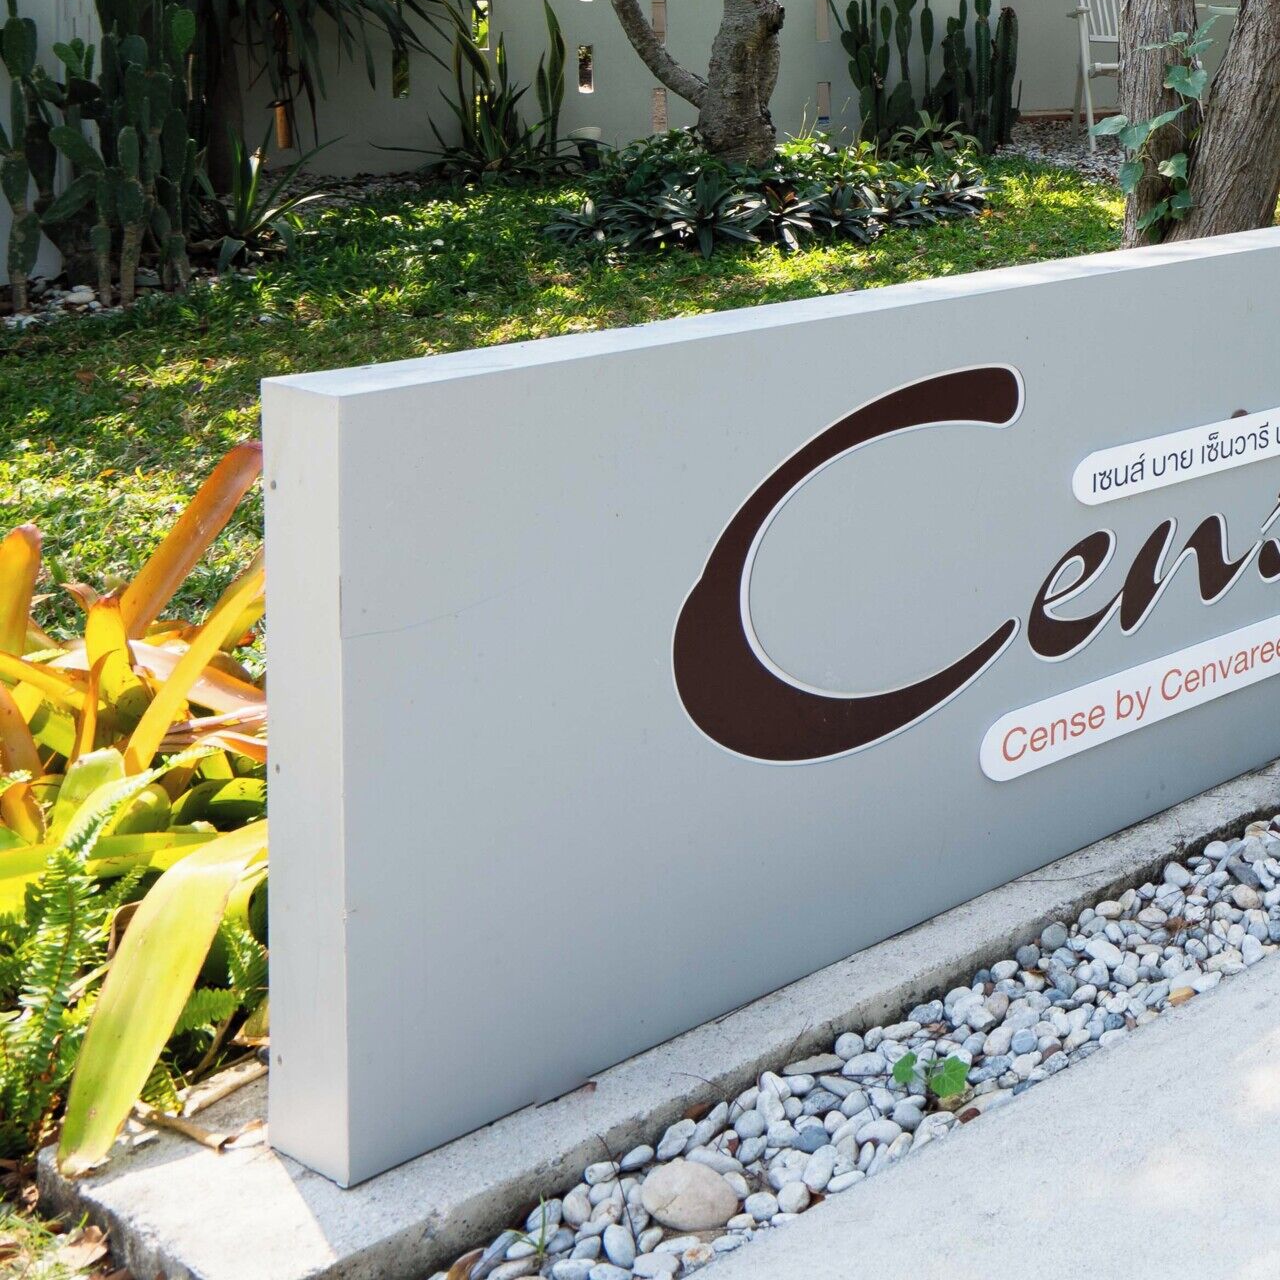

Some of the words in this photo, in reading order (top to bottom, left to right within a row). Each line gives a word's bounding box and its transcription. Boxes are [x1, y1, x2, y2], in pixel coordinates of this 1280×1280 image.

[1092, 452, 1146, 493] เซนส์
[1152, 448, 1194, 477] บาย
[1201, 421, 1270, 464] เซ็นวารี
[1002, 704, 1106, 762] Cense
[1116, 686, 1152, 721] by
